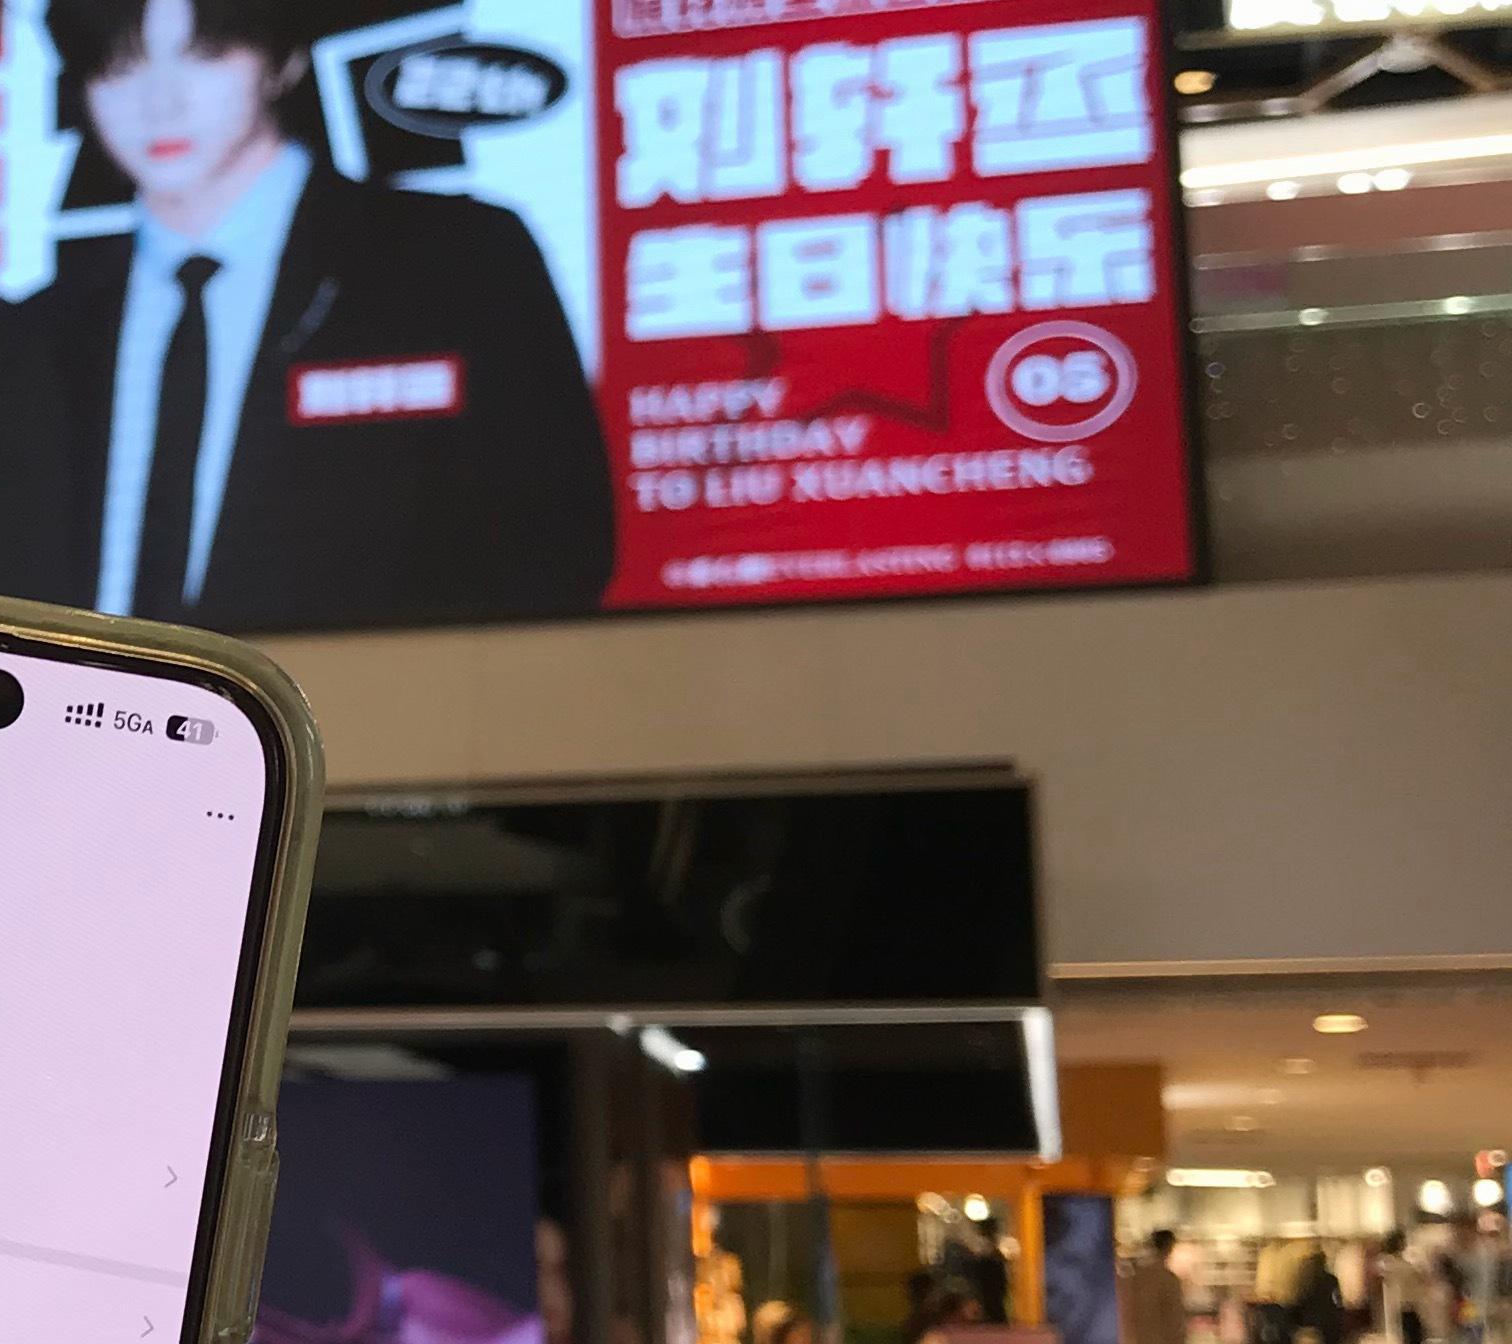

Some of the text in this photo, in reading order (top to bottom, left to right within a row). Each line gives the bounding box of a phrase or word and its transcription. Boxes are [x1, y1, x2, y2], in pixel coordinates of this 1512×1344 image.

[614, 15, 1154, 209] 刘轩丞
[624, 187, 1156, 342] 生日快乐
[628, 376, 787, 426] HAPPY
[630, 414, 869, 468] BIRTHDAY
[629, 445, 1093, 512] TO LIU XUANCHENG
[175, 719, 203, 741] 41
